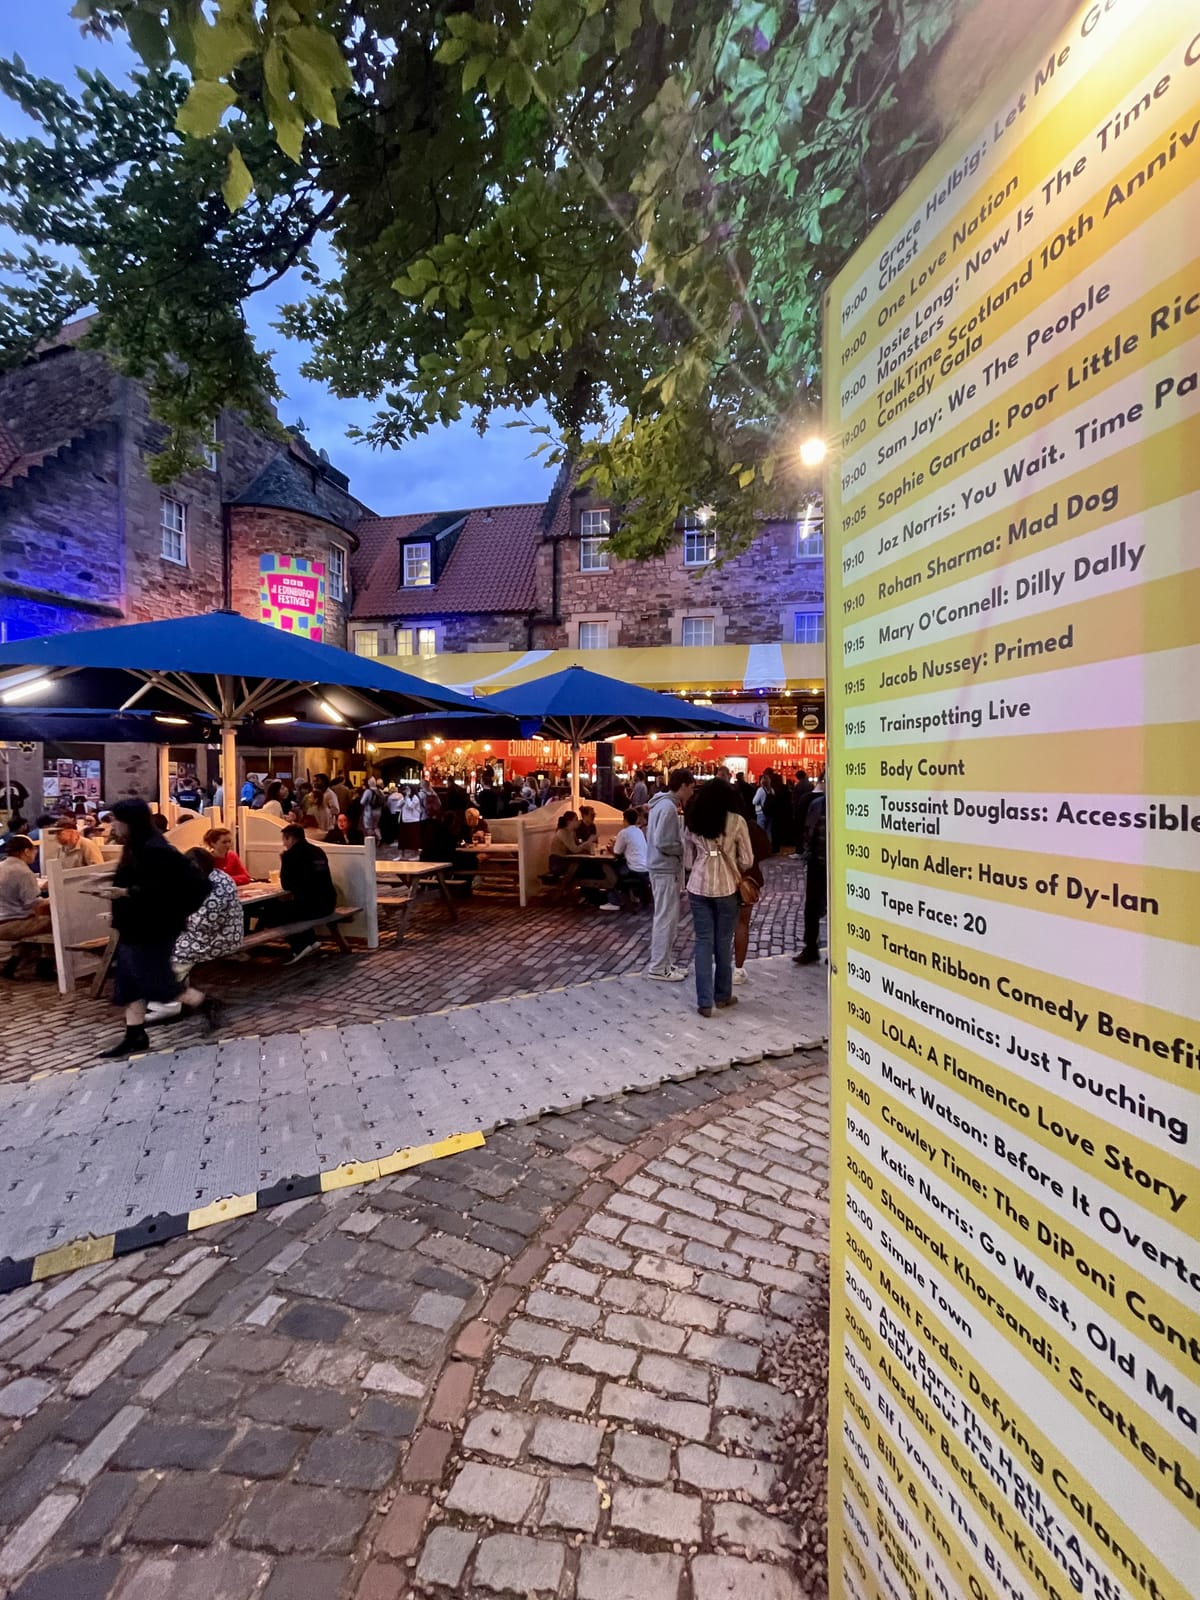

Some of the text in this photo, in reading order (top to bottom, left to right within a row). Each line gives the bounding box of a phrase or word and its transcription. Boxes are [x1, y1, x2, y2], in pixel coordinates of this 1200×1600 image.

[877, 74, 1171, 366] Josie Long: Now Is The Time
[879, 46, 1071, 272] Grace Helbig: Let Me
[841, 175, 1018, 367] 19:00 One Love Nation
[841, 286, 867, 325] 19:00
[878, 239, 918, 291] Chest
[948, 261, 1034, 350] Scotland
[1040, 213, 1093, 271] 10th
[841, 284, 1110, 491] 19:00 Sam Jay: We The People
[841, 374, 866, 408] 19:00
[877, 314, 944, 384] Monsters
[877, 335, 983, 428] Comedy Gala
[842, 333, 1139, 532] 19:05 Sophie Garrad: Poor Little
[842, 372, 1198, 573] 19:10 Joz Norris: You Wait. Time Pa
[843, 484, 1119, 614] 19:10 Rohan Sharma: Mad Dog
[843, 541, 1146, 655] 19:15 Mary O'Connell: Dilly Dally
[844, 624, 1073, 695] 19:15 Jacob Nussey: Primed
[845, 698, 1031, 736] 19:15 Trainspotting Live
[748, 739, 802, 755] EDINBURGH
[845, 758, 965, 781] 19:15 Body Count
[846, 803, 869, 817] 19:25
[880, 795, 949, 815] Toussaint
[954, 797, 1048, 825] Douglass:
[846, 843, 1159, 915] 19:30 Dylan Adler: Haus of Dy-lan
[880, 814, 940, 835] Material
[847, 883, 987, 936] 19:30 Tape Face: 20
[847, 922, 871, 942] 19:30
[881, 934, 927, 966] Tartan
[931, 952, 990, 990] Ribbon
[997, 976, 1089, 1032] Comedy
[847, 962, 1188, 1145] 19:30 Wankernomics: Just Touching
[847, 1001, 1187, 1213] 19:30 LOLA: A Flamenco Love Story
[847, 1040, 1091, 1217] 19:30 Mark Watson: Before It
[847, 1078, 870, 1106] 19:40
[881, 1105, 937, 1162] Crowley
[941, 1148, 987, 1199] Time:
[994, 1187, 1030, 1231] The
[1038, 1220, 1115, 1298] DiPoni
[845, 1270, 872, 1312] 20:00
[846, 1194, 972, 1339] 20:00 Simple Town
[846, 1156, 1200, 1510] 20:00 Shaparak Khorsandi: Scatterb
[847, 1117, 1198, 1434] 19:40 Katie Norris: Go West, Old Ma
[845, 1307, 936, 1436] 20:00 Alasdair
[846, 1232, 1044, 1475] 20:00 Matt Forde: Defying
[879, 1306, 992, 1453] Andy Barr: The
[843, 1420, 870, 1470] 20:00
[844, 1382, 870, 1430] 20:00
[877, 1433, 904, 1484] Billy
[908, 1482, 919, 1508] &
[923, 1501, 951, 1556] Tim
[845, 1345, 871, 1391] 20:00
[878, 1392, 895, 1426] Elf
[898, 1421, 943, 1498] Lyons:
[949, 1491, 978, 1548] The
[879, 1321, 1083, 1594] Debut Hour from Rising
